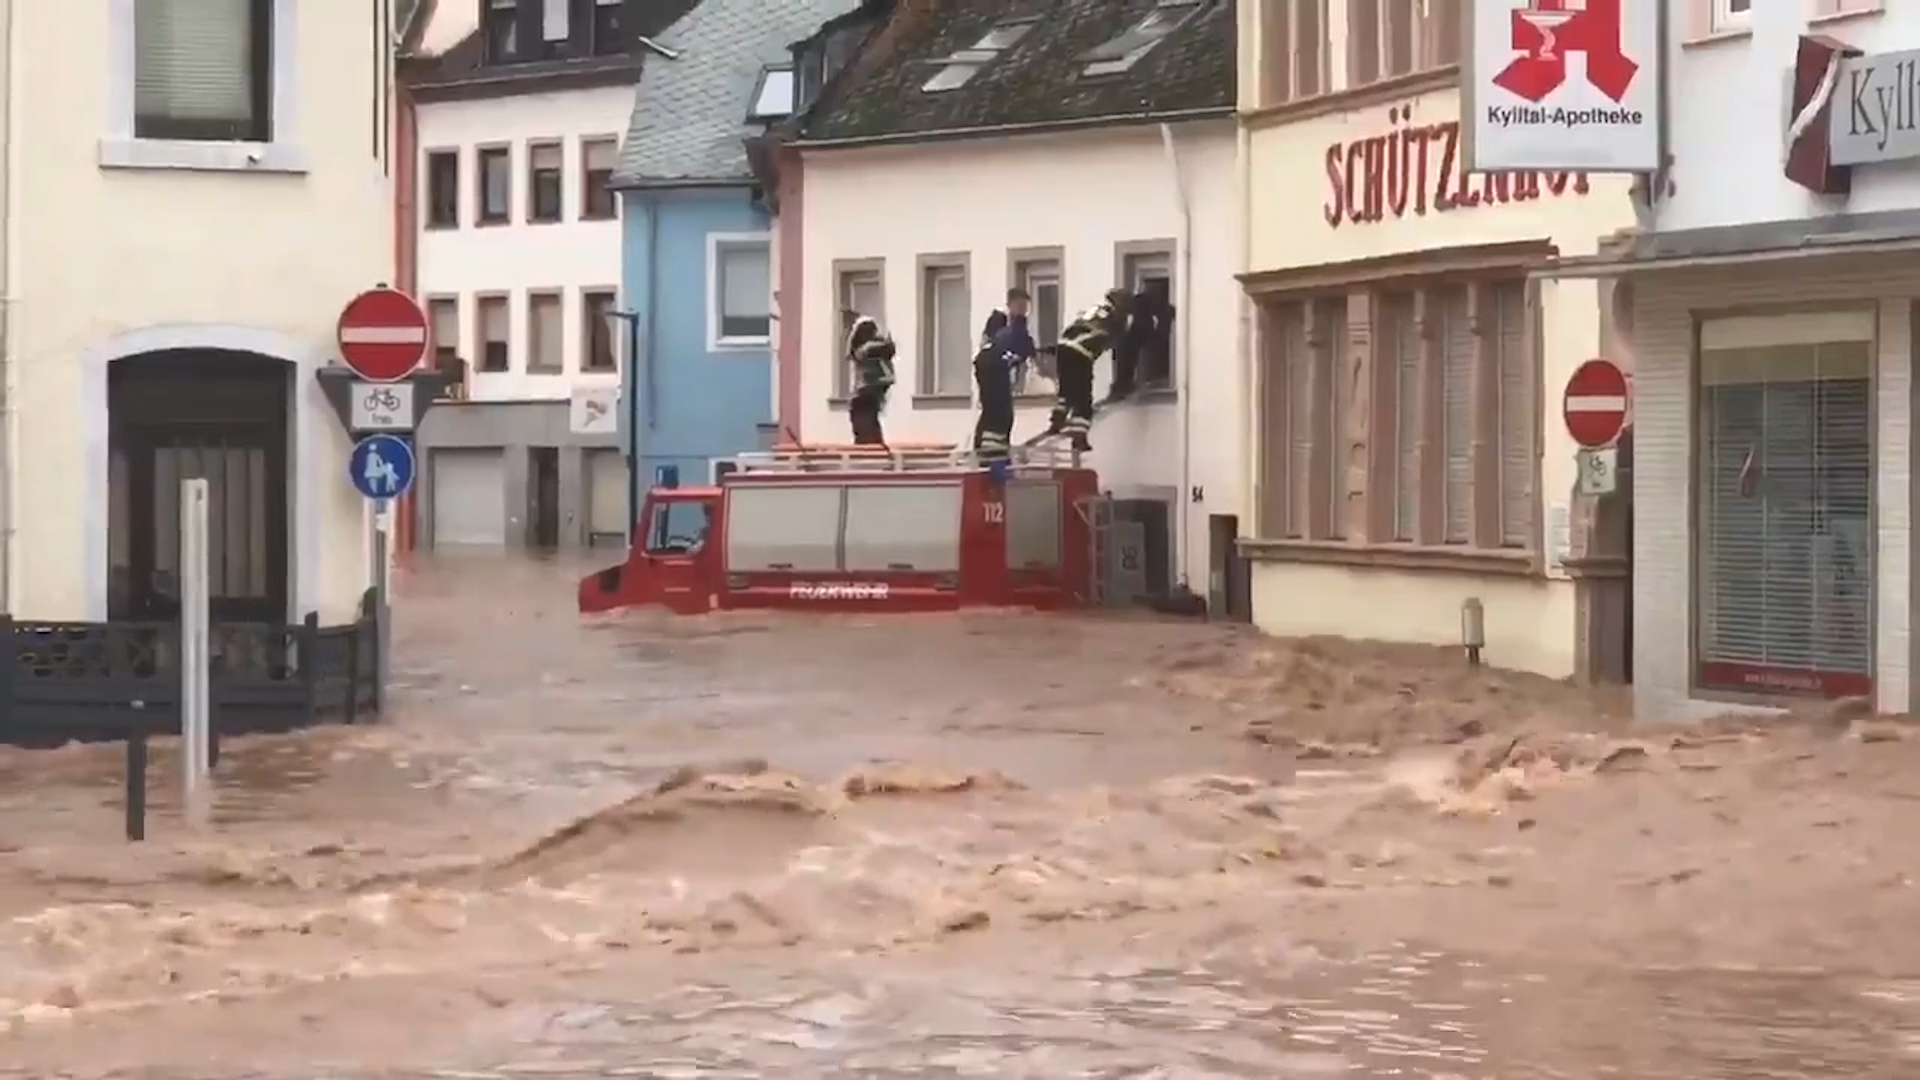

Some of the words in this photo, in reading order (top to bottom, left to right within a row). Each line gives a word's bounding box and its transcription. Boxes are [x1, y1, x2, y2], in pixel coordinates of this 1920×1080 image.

[1487, 105, 1643, 128] Kylltal-Apotheke
[1848, 60, 1920, 152] Kyll
[1324, 104, 1589, 230] SCHÜTZ
[982, 502, 1004, 522] 112
[790, 581, 889, 600] FEUERWEHR
